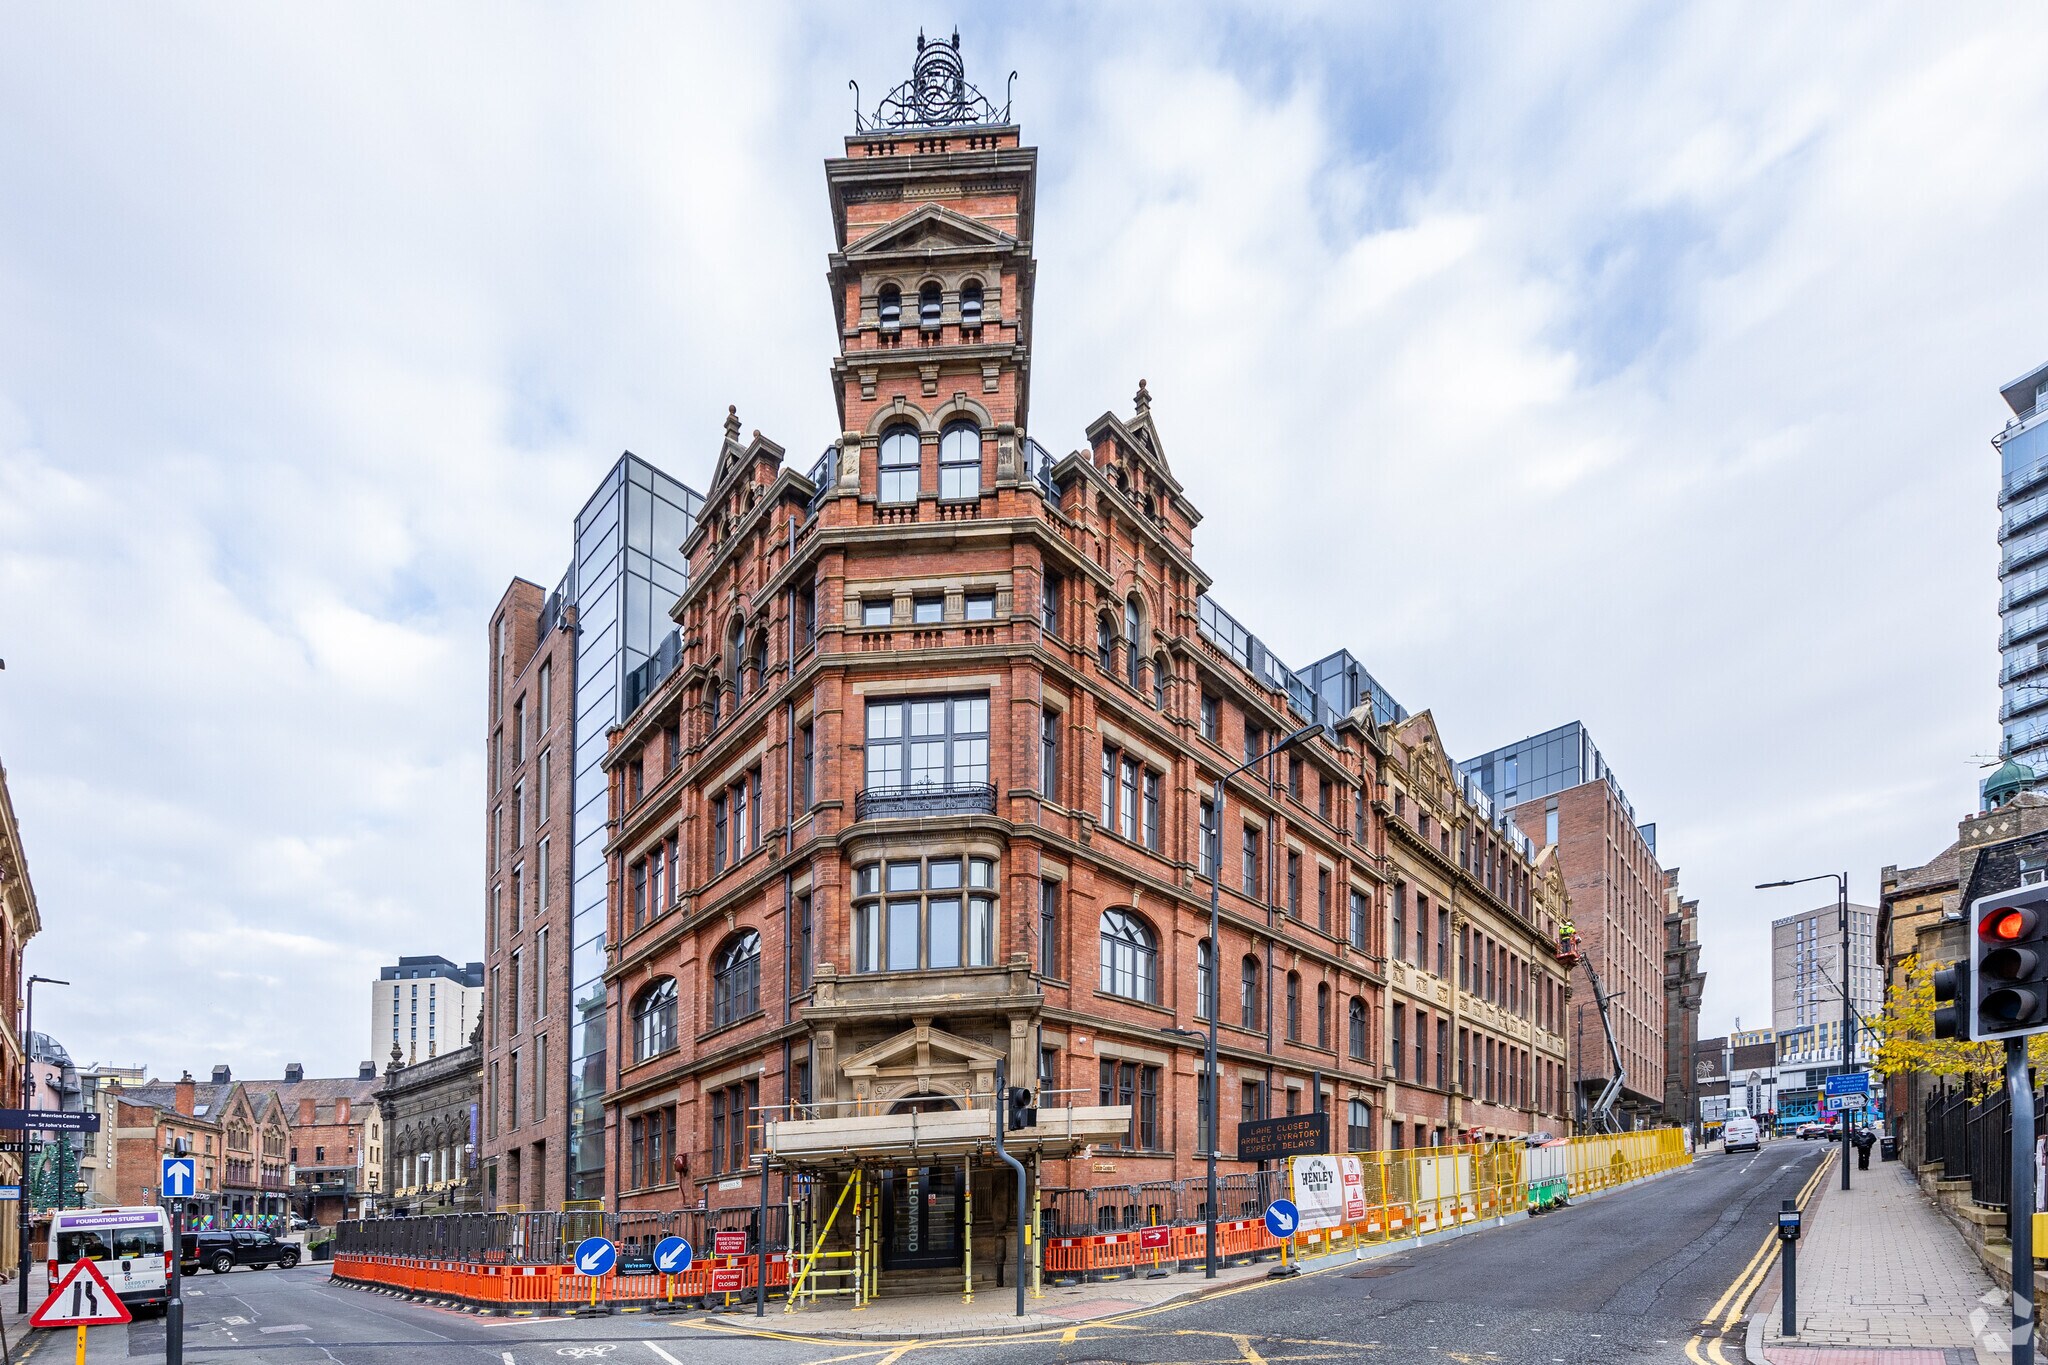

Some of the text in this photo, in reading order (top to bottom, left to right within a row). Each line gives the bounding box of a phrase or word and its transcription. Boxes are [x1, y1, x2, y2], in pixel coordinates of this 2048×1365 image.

[1250, 1121, 1309, 1135] LANE CLOSED
[1241, 1129, 1320, 1145] ARMLEY GYRATORY
[1245, 1139, 1315, 1153] EXPECT DELAYS
[1301, 1171, 1333, 1185] HENLEY
[76, 1217, 117, 1225] FOUNDATION
[908, 1181, 919, 1252] LEONARDO
